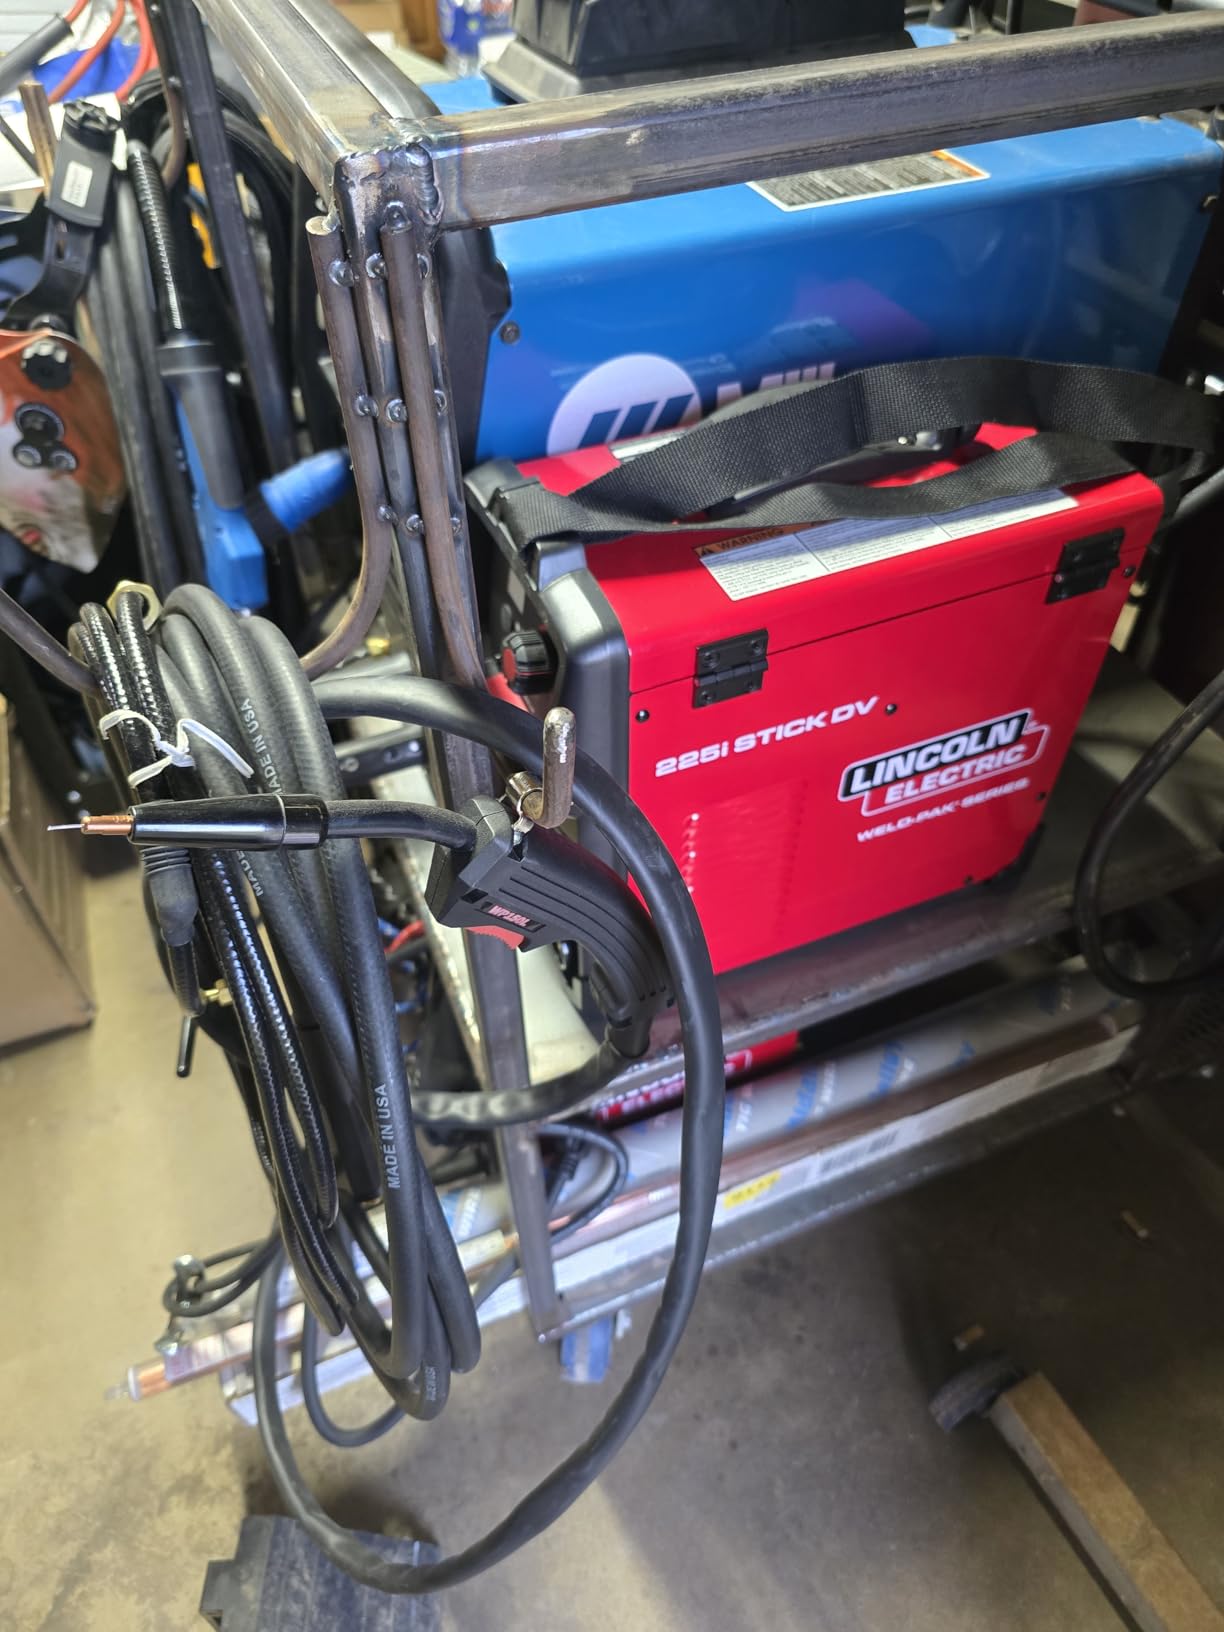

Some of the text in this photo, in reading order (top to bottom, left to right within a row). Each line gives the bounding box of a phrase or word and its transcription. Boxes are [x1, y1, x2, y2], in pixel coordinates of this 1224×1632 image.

[240, 698, 260, 734] USA
[252, 734, 267, 753] IN
[733, 711, 828, 752] STICK
[830, 696, 879, 724] DV
[850, 717, 1021, 793] LINCOLN
[884, 744, 1026, 805] ELECTRIC
[374, 1083, 401, 1189] MADE IN USA
